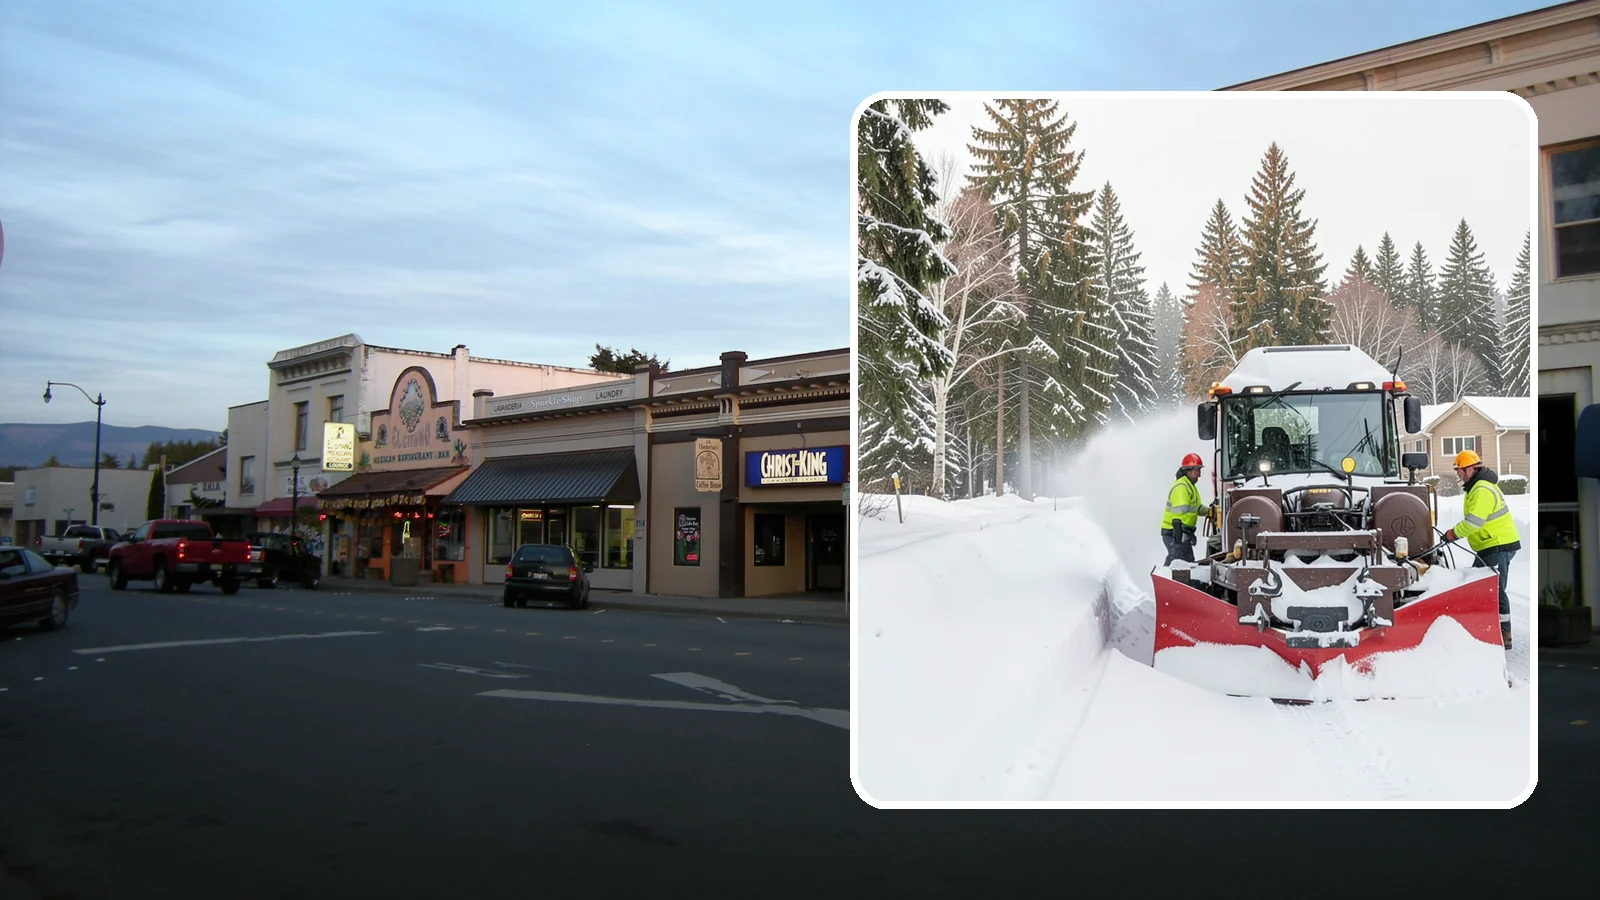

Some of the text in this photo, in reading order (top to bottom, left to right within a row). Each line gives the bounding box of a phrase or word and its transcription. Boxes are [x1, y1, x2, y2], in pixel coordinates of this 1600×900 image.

[595, 389, 624, 400] LAUNDRY
[493, 402, 522, 413] LAVANDERIA
[373, 455, 396, 464] MEXICAN
[397, 451, 434, 462] RESTAURANT
[437, 450, 450, 459] BAR
[761, 449, 827, 479] CHRIST KING
